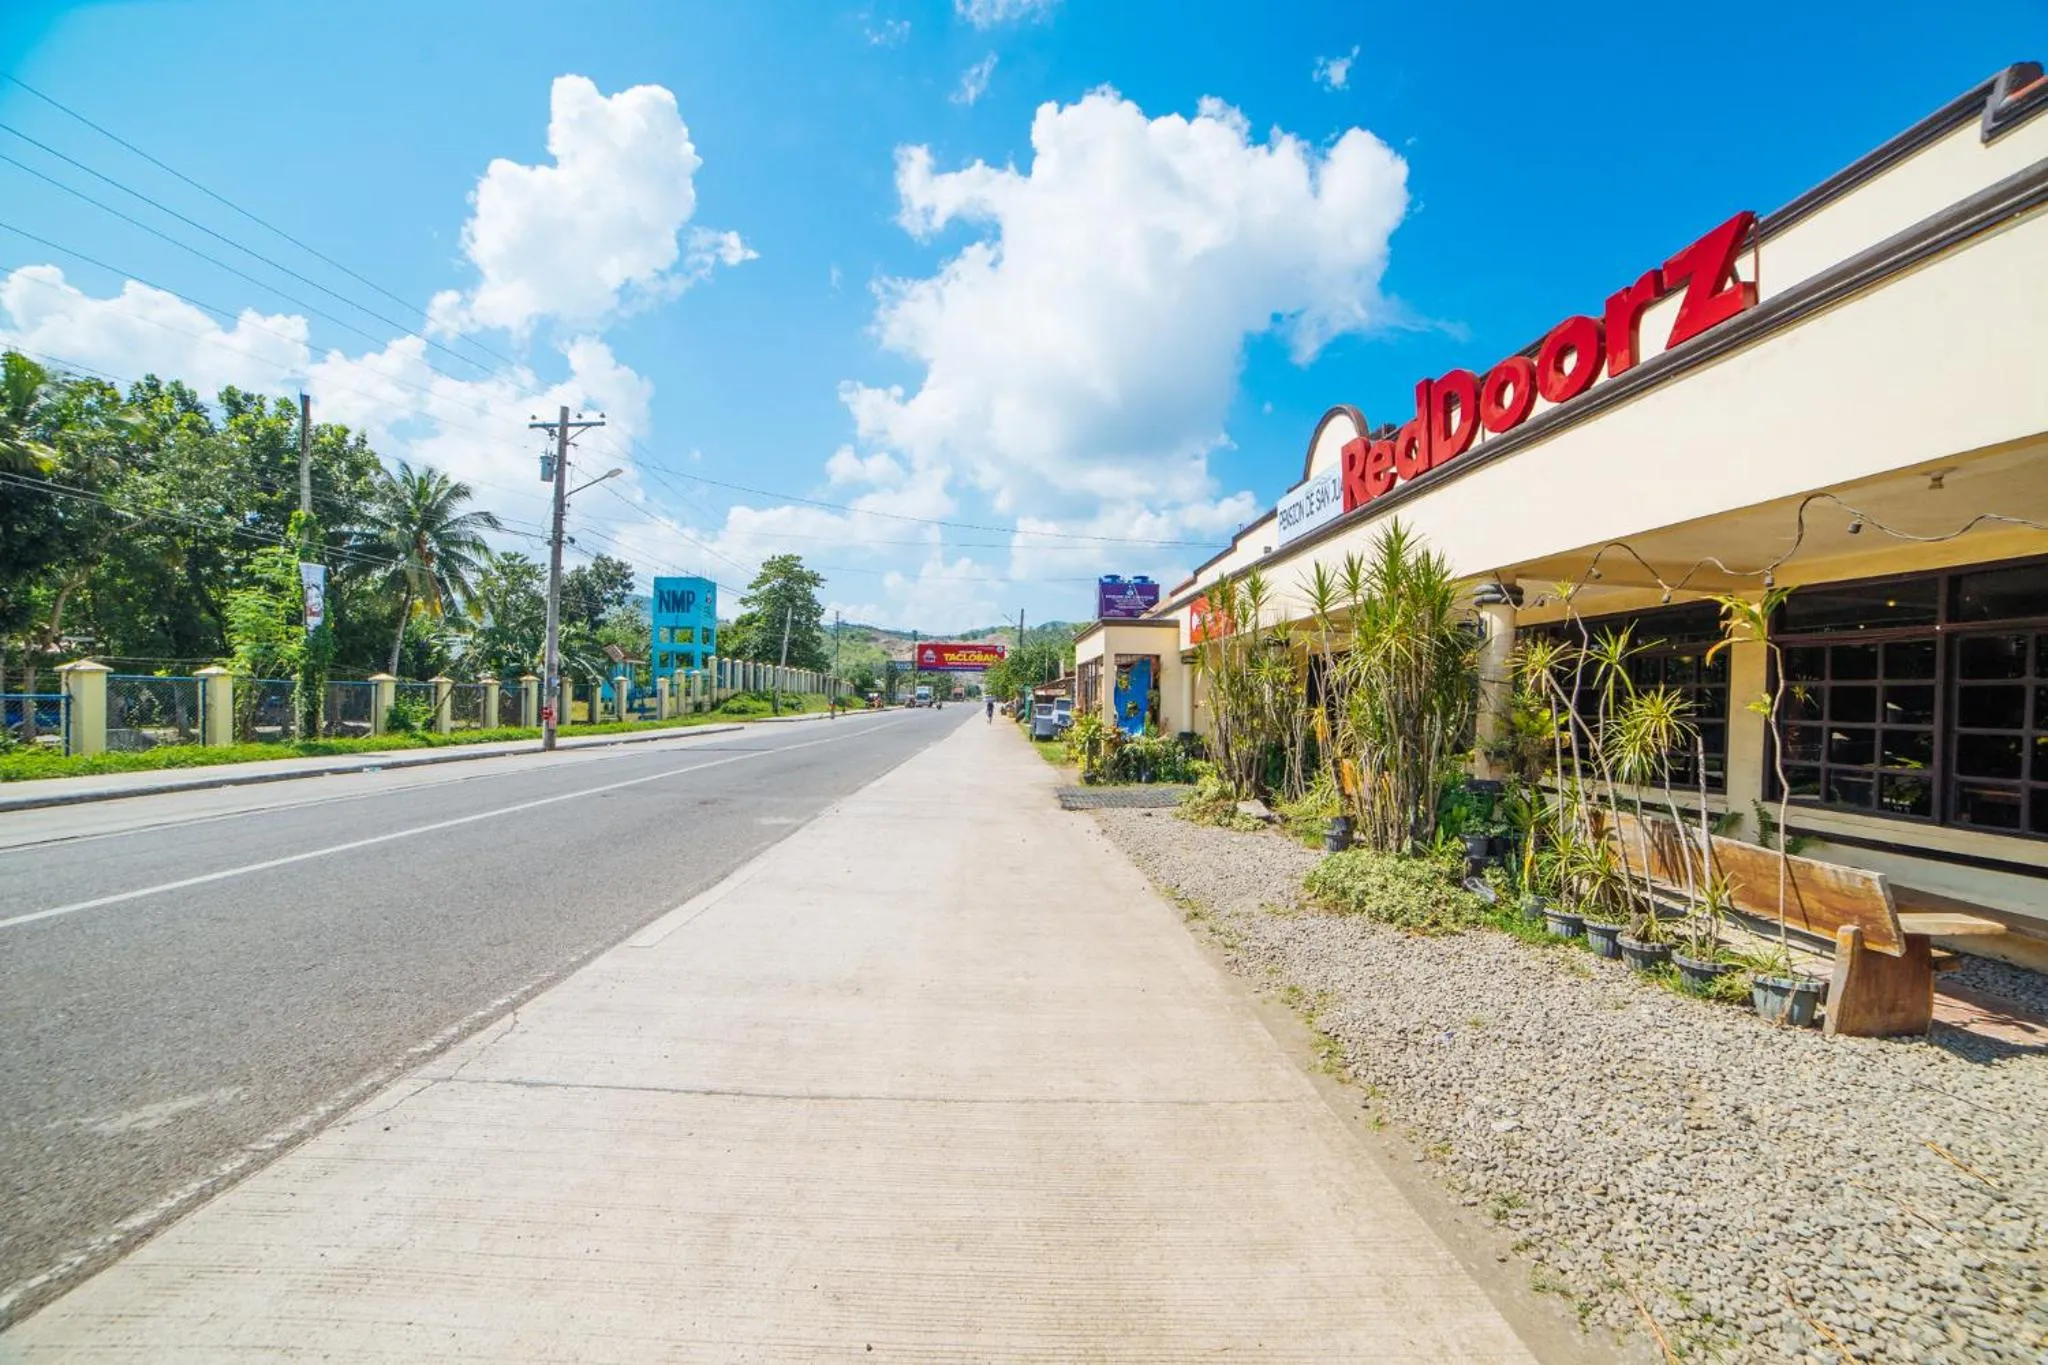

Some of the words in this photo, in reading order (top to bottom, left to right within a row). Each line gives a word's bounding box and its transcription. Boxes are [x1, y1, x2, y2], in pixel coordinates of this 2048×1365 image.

[1279, 501, 1304, 530] PENSION
[1305, 492, 1314, 517] DE
[1316, 485, 1330, 511] SAN
[1332, 477, 1343, 502] JU
[658, 589, 695, 613] NMP
